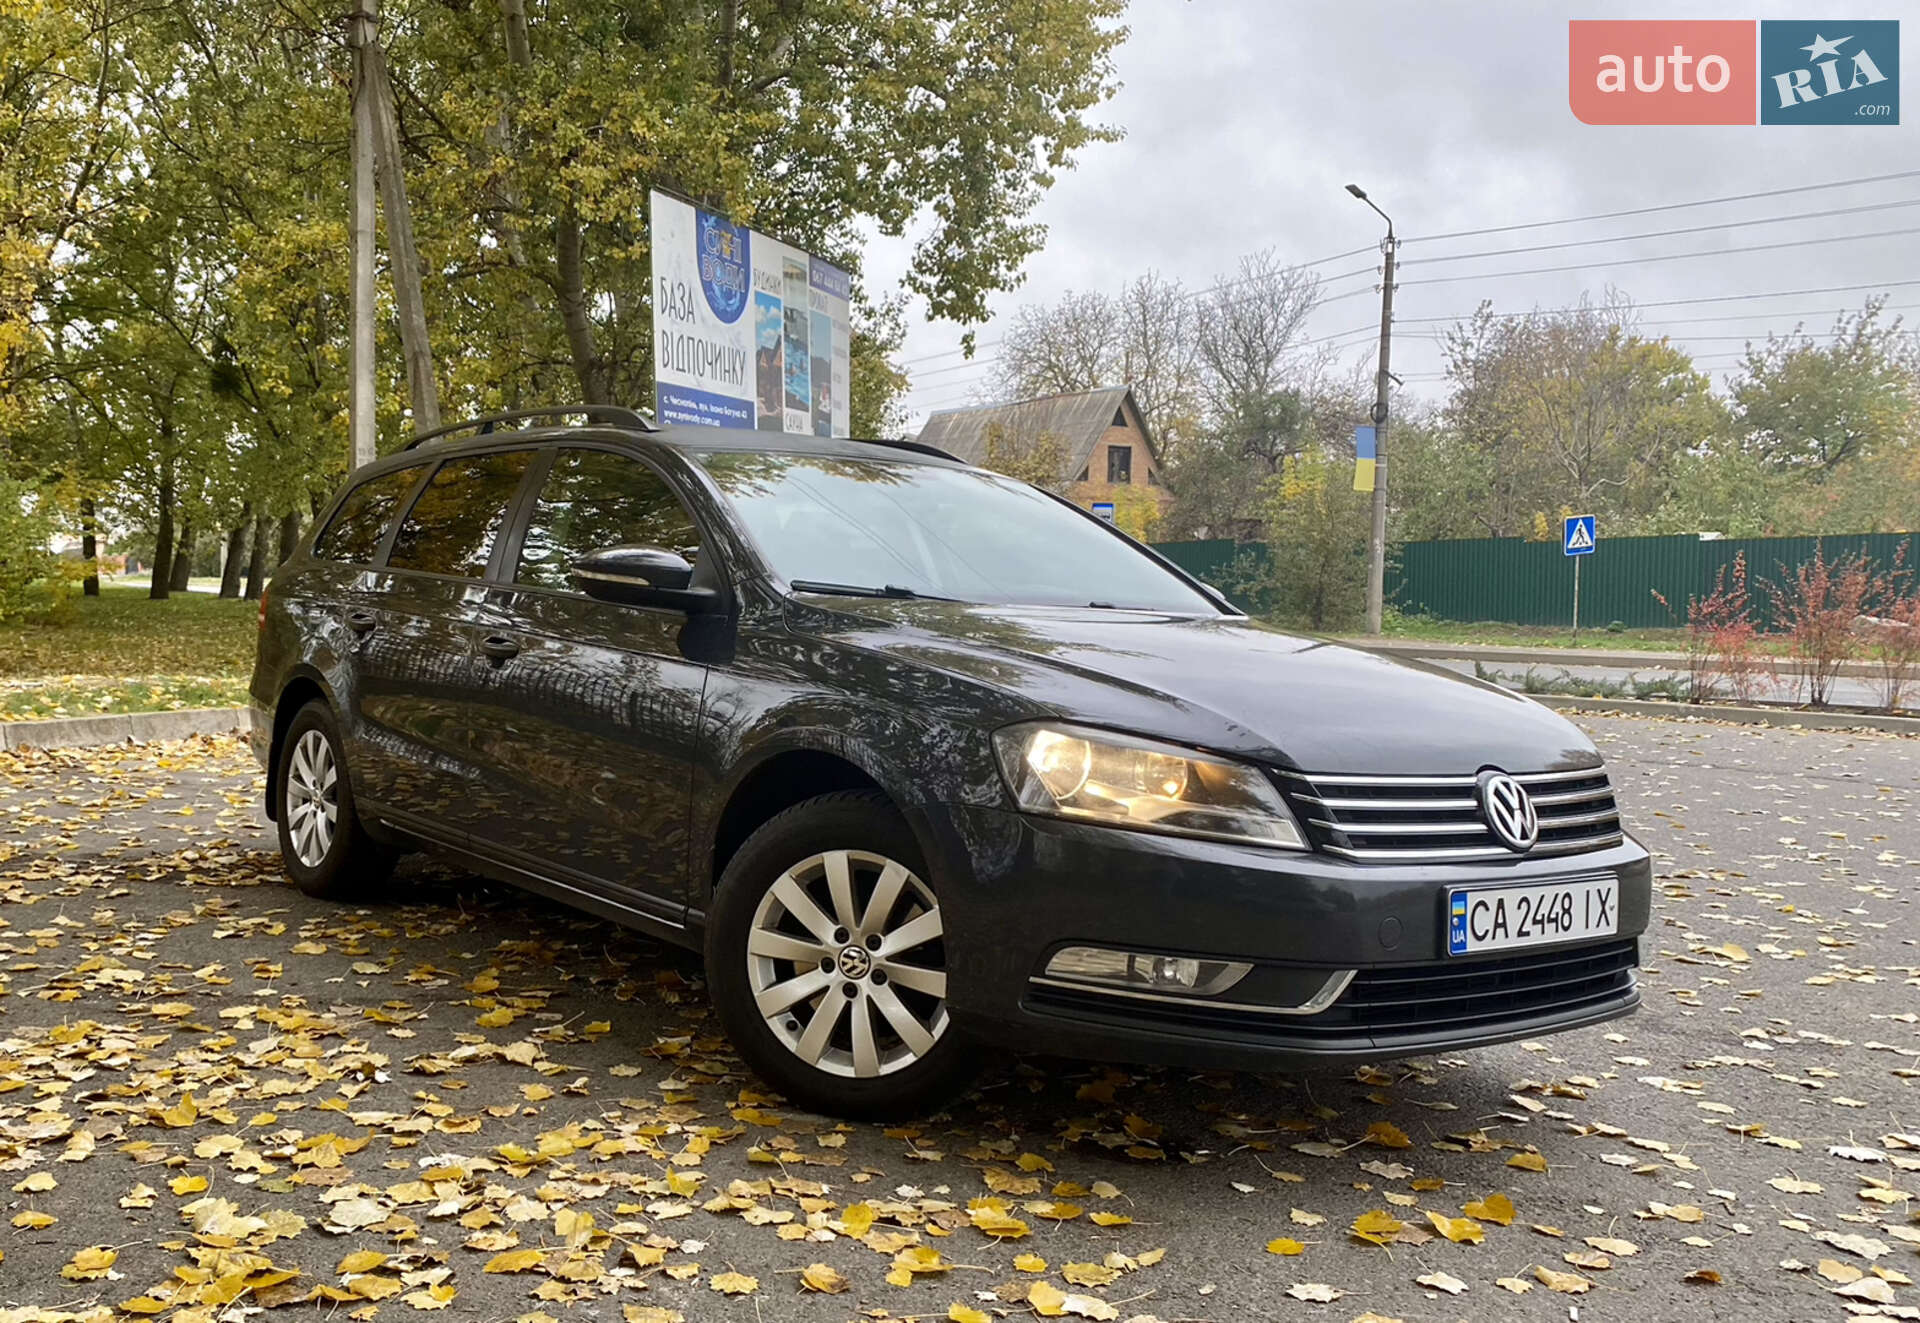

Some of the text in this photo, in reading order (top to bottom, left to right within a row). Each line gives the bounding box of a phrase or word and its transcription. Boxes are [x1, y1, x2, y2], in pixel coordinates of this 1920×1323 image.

[660, 276, 696, 325] БАЗА
[662, 329, 746, 386] ВІДПОЧИНКУ
[1452, 930, 1466, 944] UA
[1470, 887, 1612, 942] CA 2448 IX
